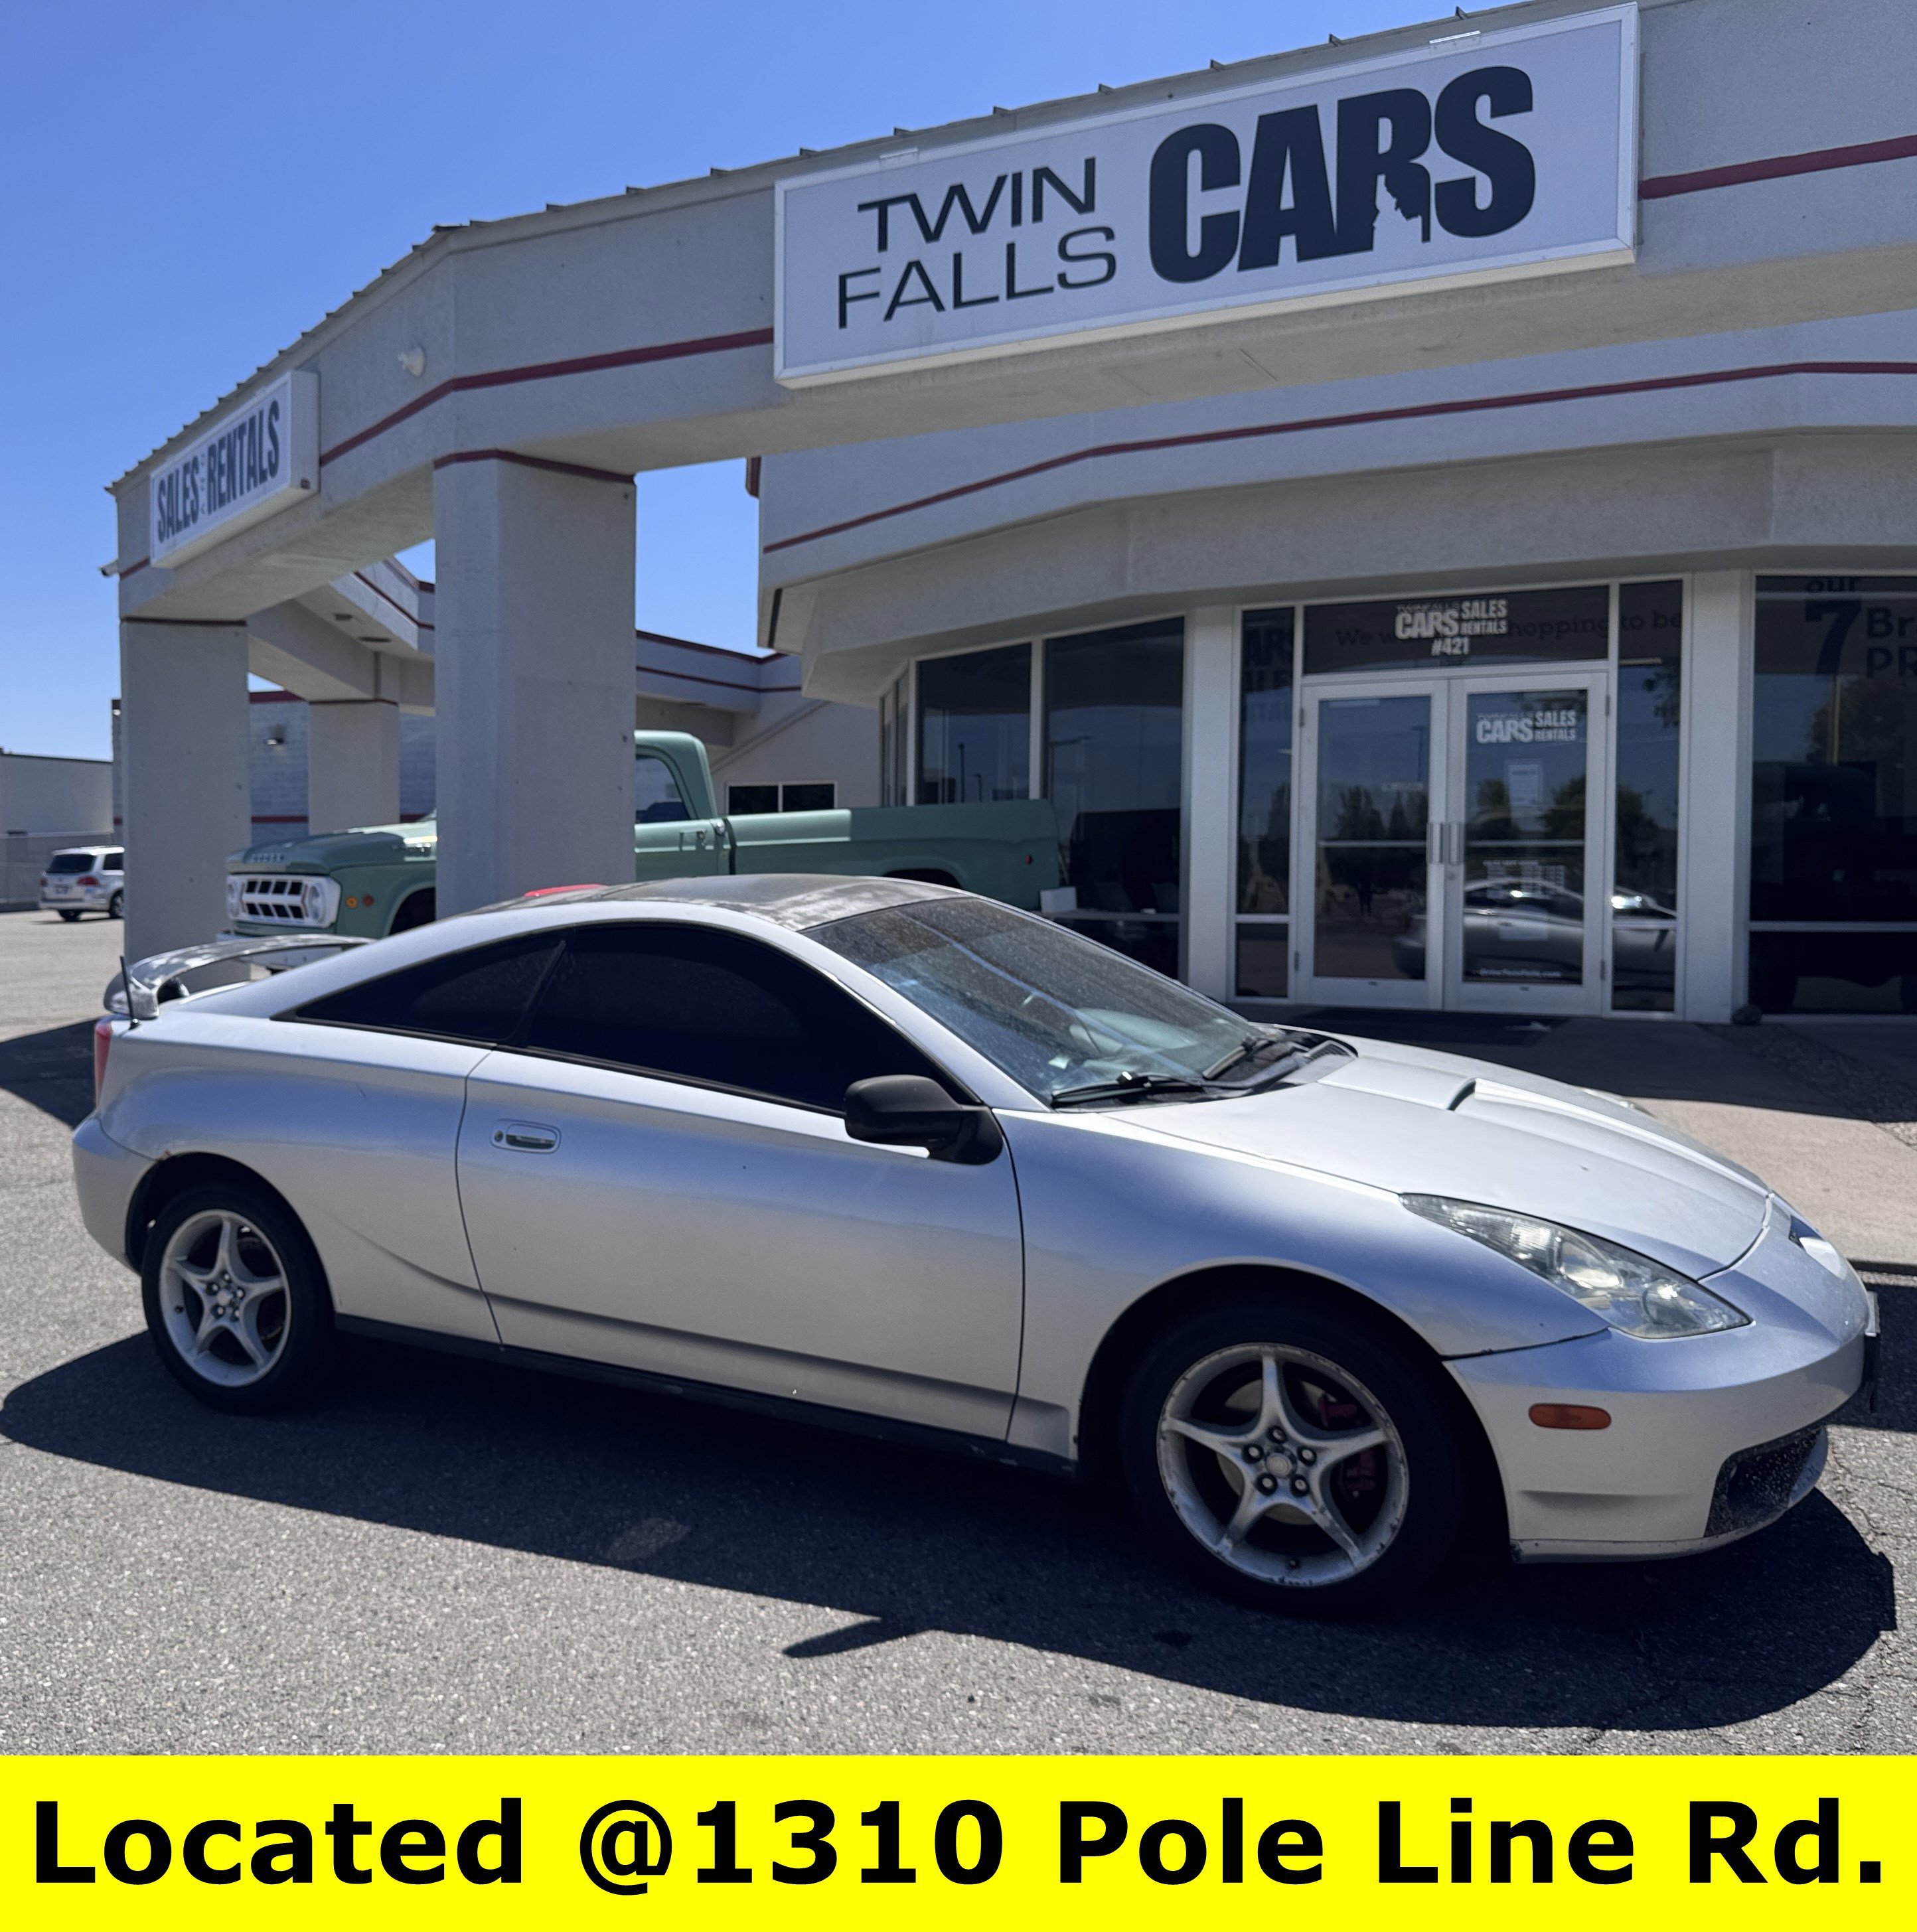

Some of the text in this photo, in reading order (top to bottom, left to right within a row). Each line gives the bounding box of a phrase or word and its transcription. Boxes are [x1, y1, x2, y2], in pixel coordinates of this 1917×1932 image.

[1148, 66, 1536, 283] CARS
[857, 157, 1096, 253] TWIN
[838, 226, 1117, 330] FALLS
[157, 400, 279, 544] SALES RENTALS
[1461, 599, 1507, 620] SALES
[1867, 606, 1917, 638] Br
[1395, 608, 1460, 639] CARS
[1461, 619, 1508, 635] RENTALS
[1507, 616, 1607, 641] hopping
[1431, 636, 1470, 656] #421
[1476, 717, 1533, 744] CARS
[1534, 709, 1576, 727] SALES
[1534, 727, 1576, 742] RENTALS
